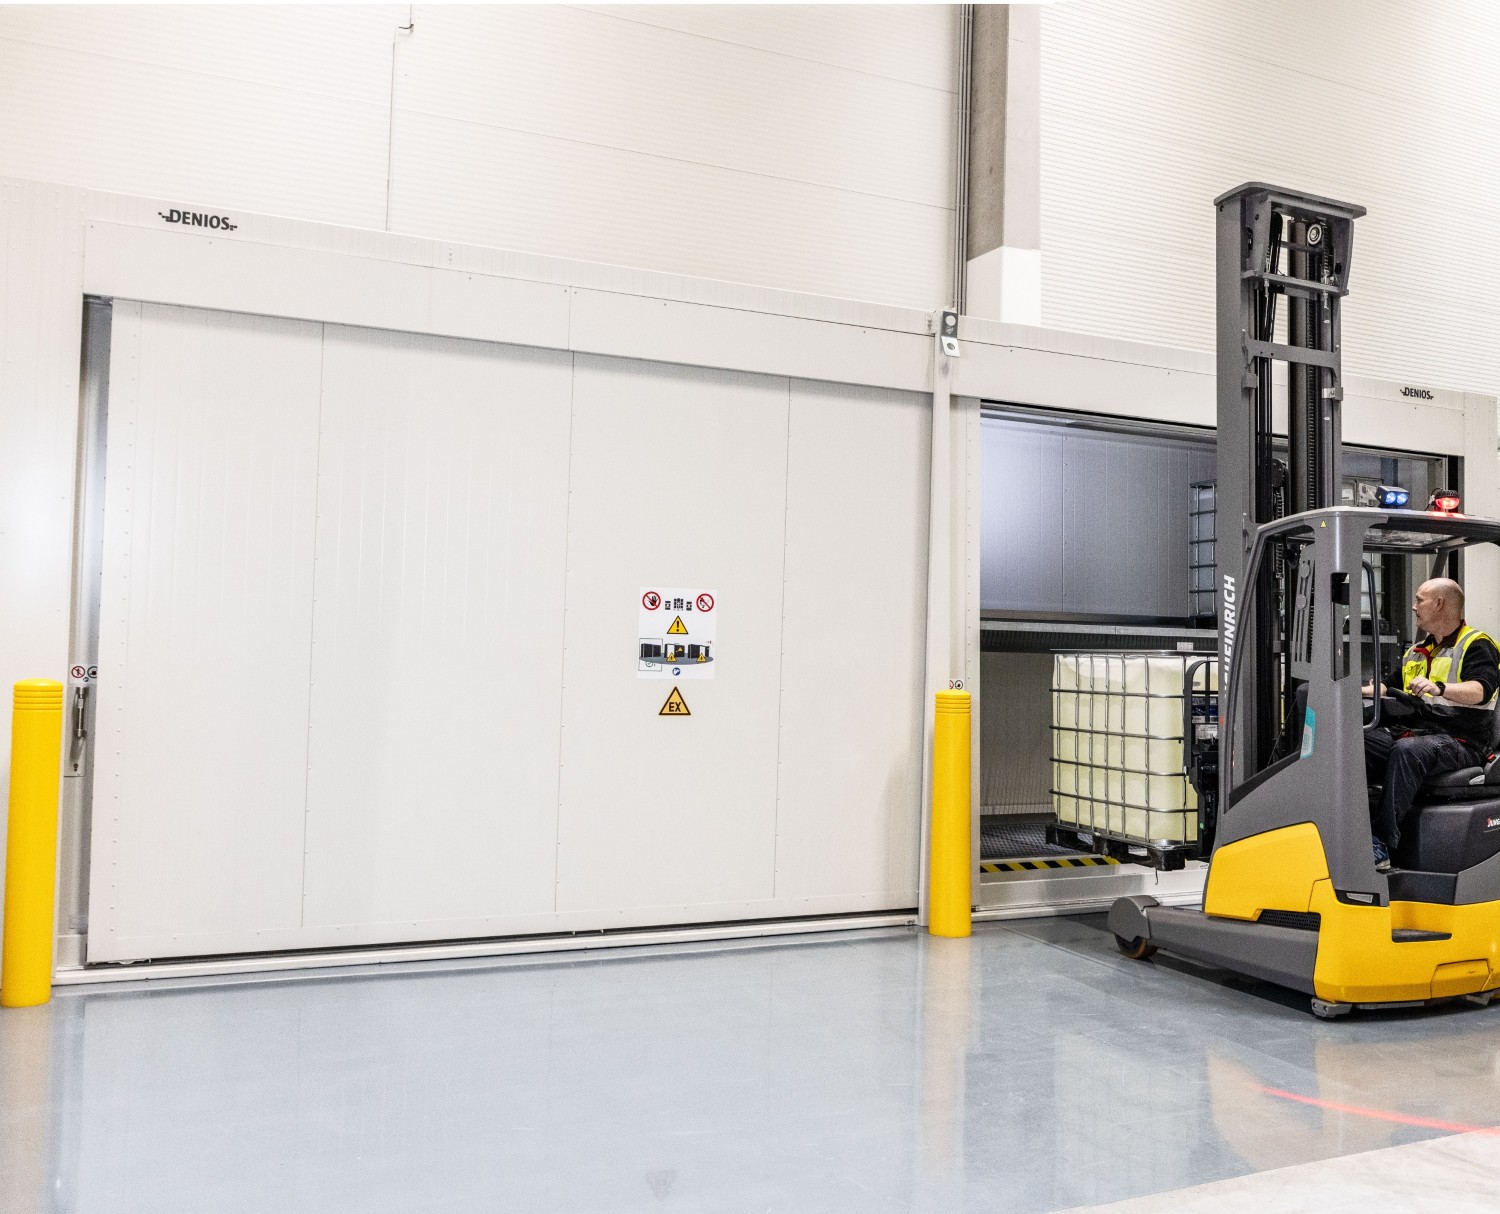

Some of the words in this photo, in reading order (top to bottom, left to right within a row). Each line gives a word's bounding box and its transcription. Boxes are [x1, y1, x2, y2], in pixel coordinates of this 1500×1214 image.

[166, 208, 232, 231] DENIOS
[1402, 386, 1432, 401] DENIOS
[668, 701, 682, 713] EX
